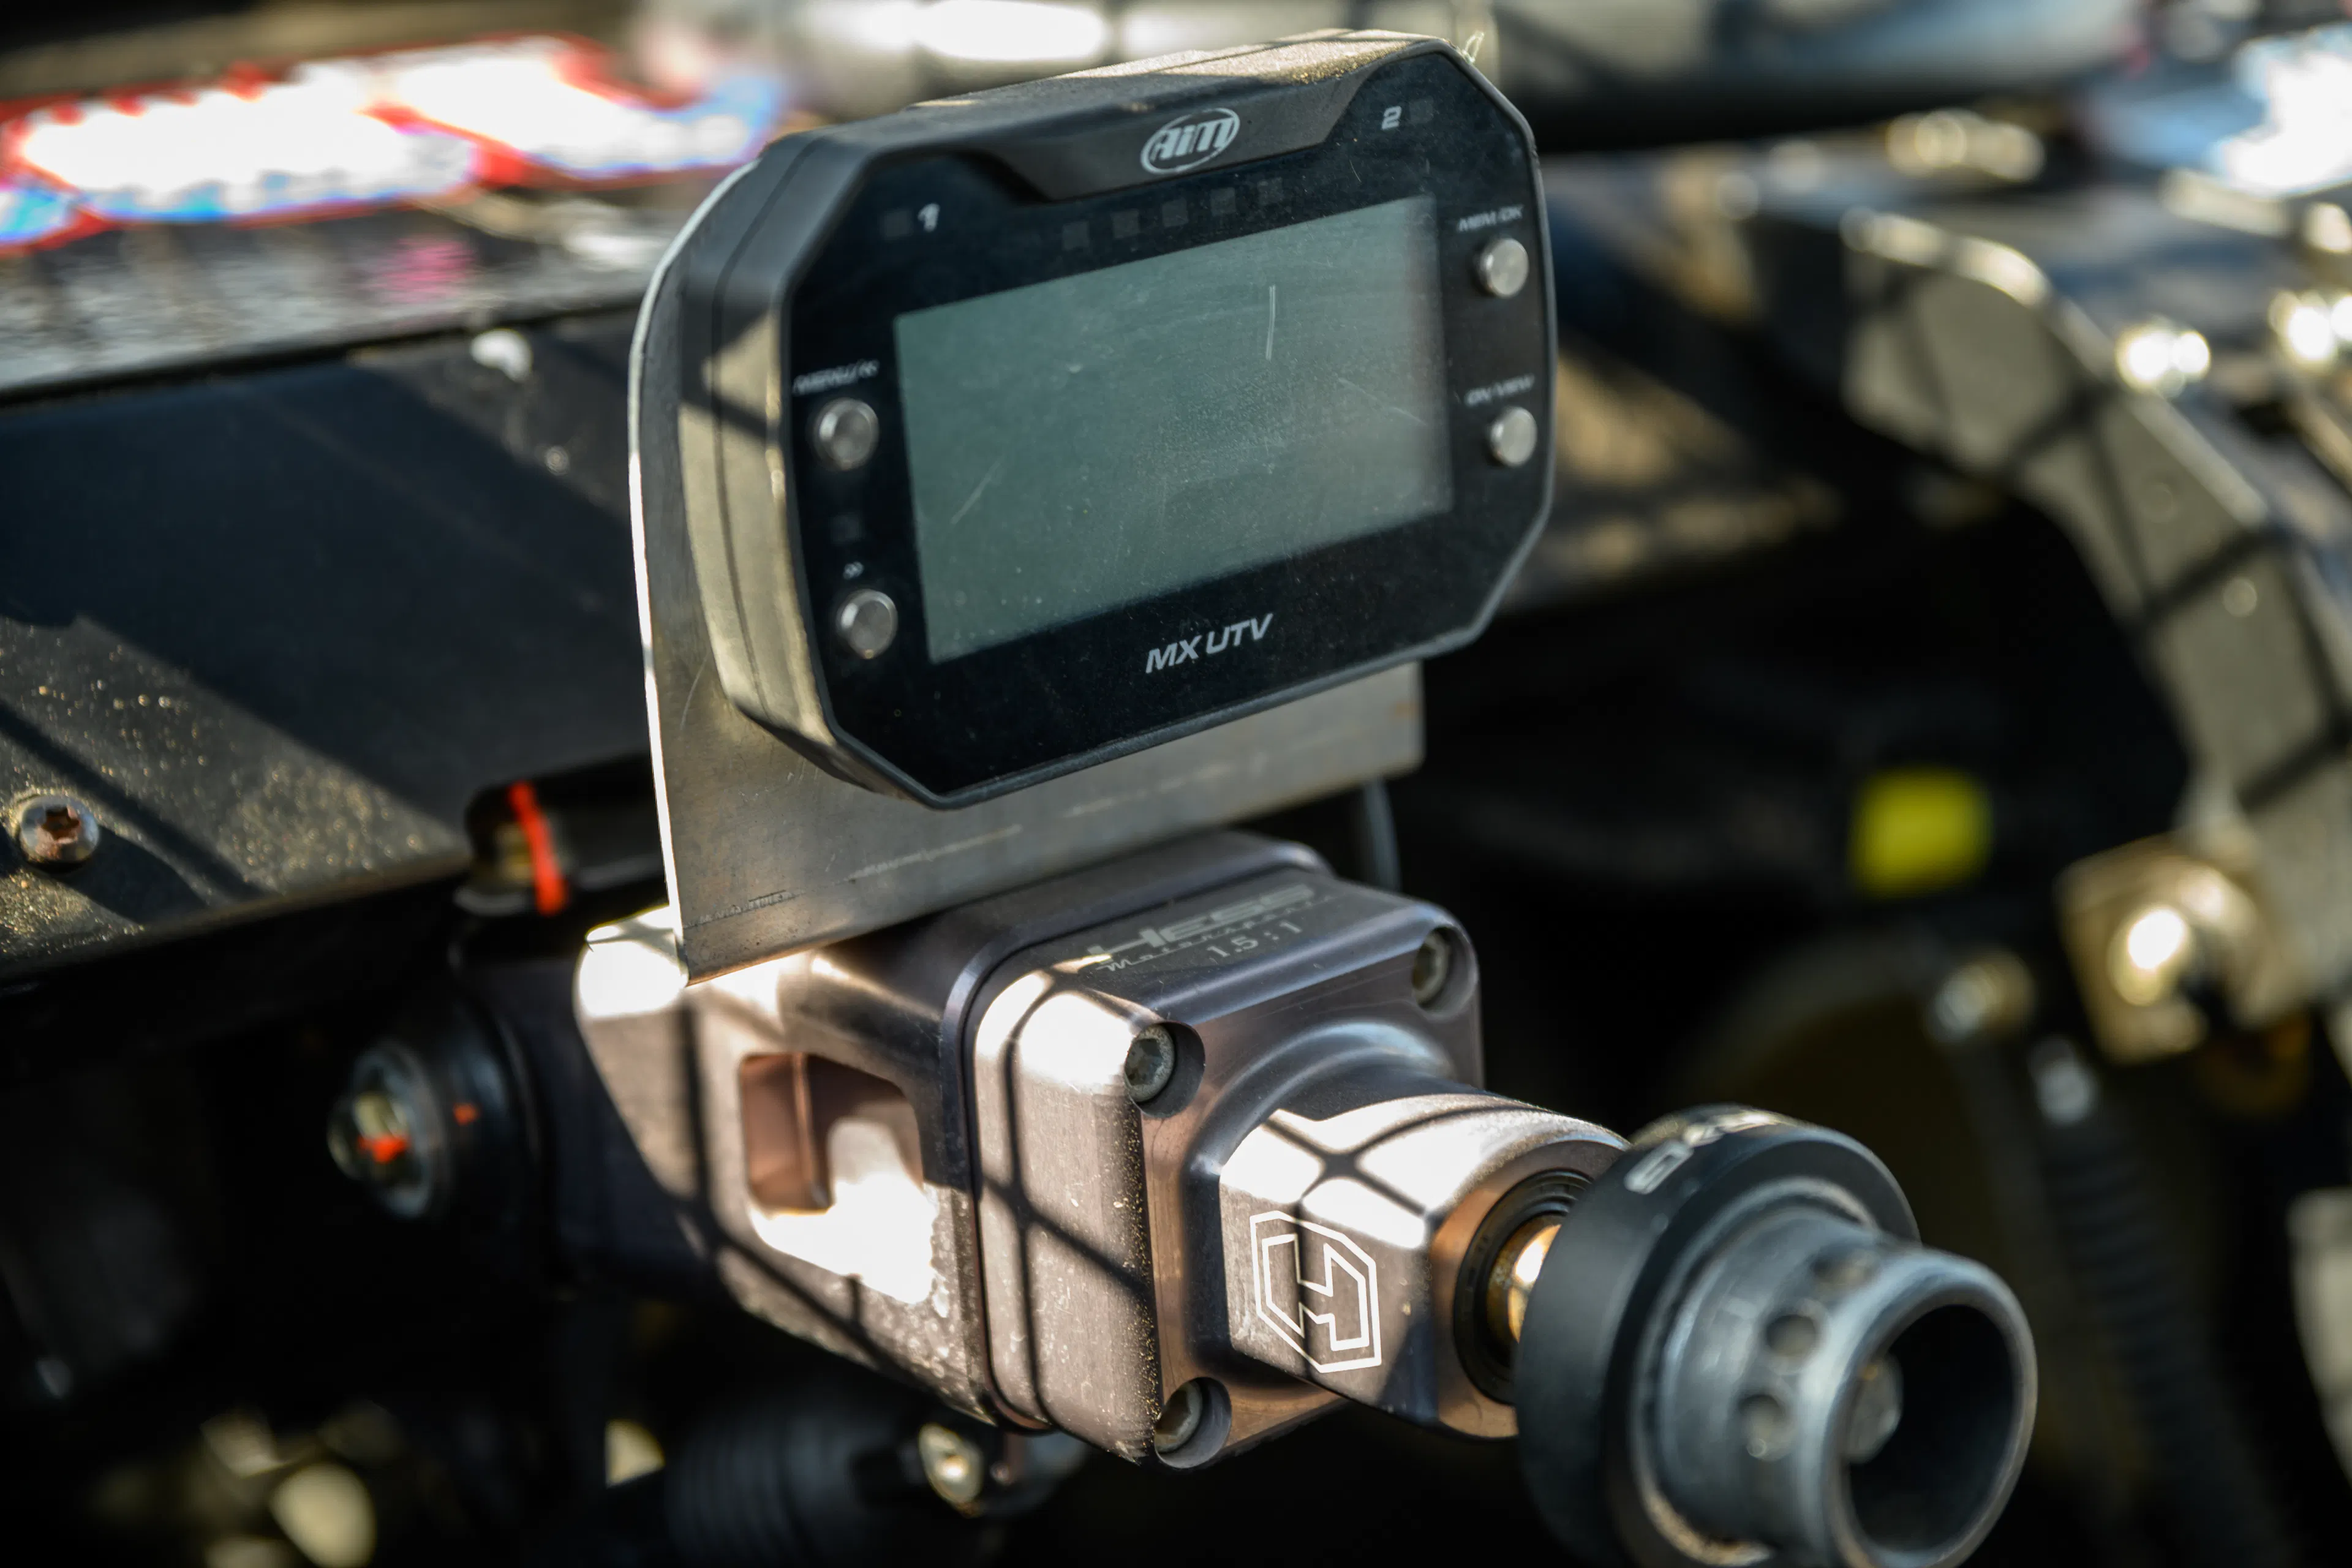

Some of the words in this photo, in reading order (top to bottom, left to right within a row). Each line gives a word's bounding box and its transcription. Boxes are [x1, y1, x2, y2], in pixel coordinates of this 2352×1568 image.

[1382, 105, 1401, 130] 2
[918, 203, 940, 232] 1
[1145, 635, 1202, 674] MX
[1205, 612, 1273, 655] UTV
